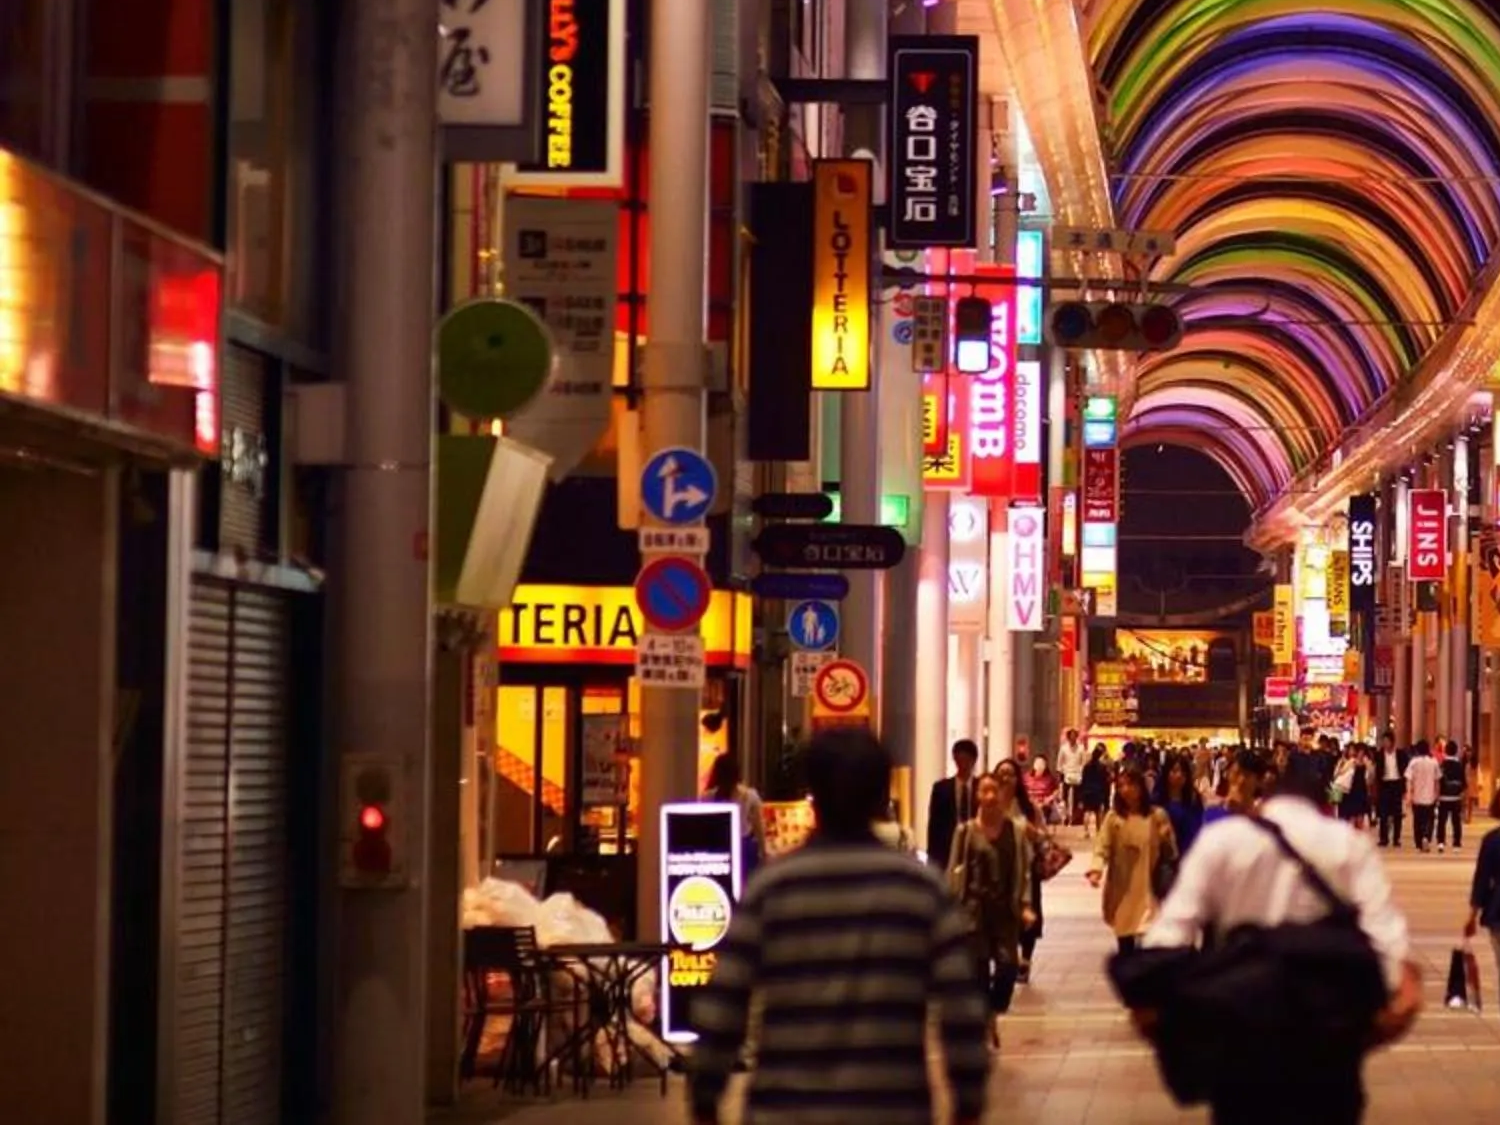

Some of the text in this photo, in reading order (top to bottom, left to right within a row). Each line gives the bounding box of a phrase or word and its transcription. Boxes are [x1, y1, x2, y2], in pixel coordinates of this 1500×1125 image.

[548, 63, 573, 168] COFFEE
[904, 105, 938, 222] 谷口宝石
[831, 209, 850, 376] LOTTERIA
[1015, 373, 1031, 451] docomo
[1014, 542, 1037, 626] HMV
[1352, 520, 1373, 585] SHIPS
